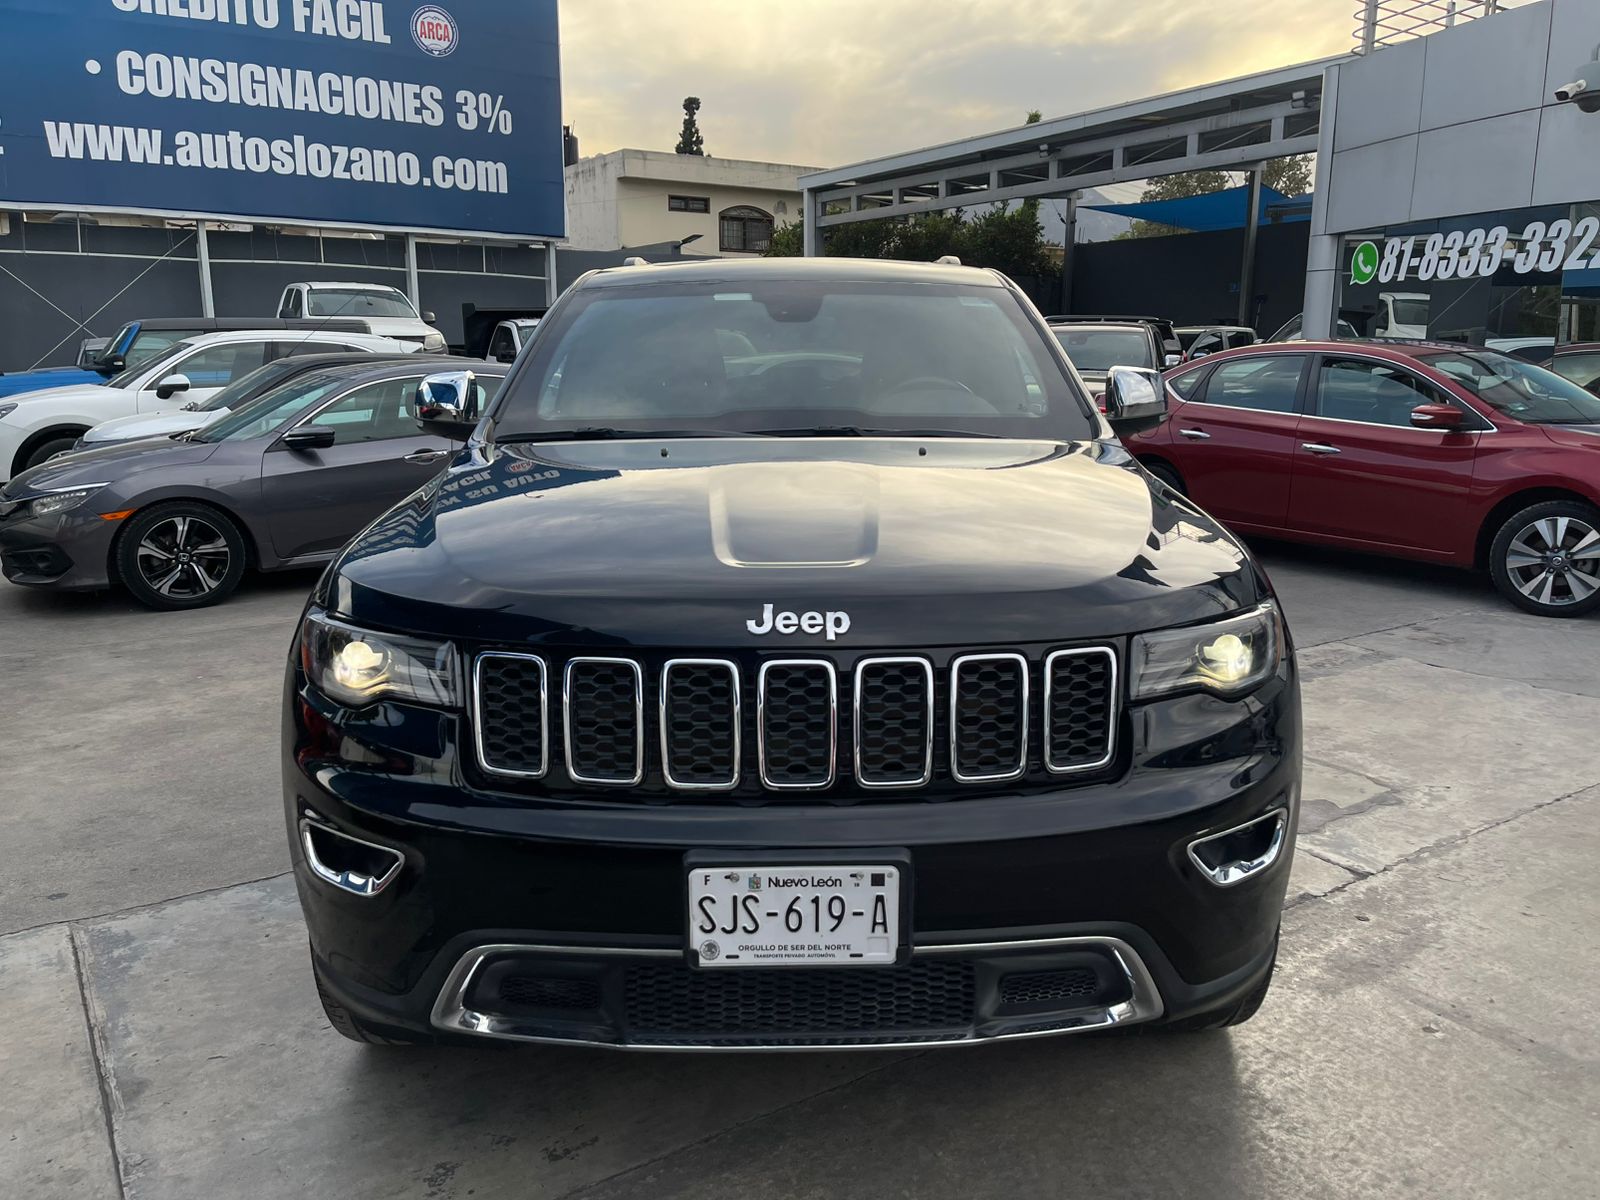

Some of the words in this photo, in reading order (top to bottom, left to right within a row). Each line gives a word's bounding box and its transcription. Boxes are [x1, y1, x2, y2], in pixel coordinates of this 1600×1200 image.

[419, 20, 451, 43] ARCA
[116, 50, 444, 127] CONSIGNACIONES
[456, 90, 513, 135] 3%
[43, 120, 508, 193] www.autoslozano.com
[1378, 216, 1600, 283] 81-8333-332
[746, 604, 851, 641] Jeep
[704, 875, 711, 886] F
[768, 877, 809, 888] Nuevo
[811, 876, 843, 888] León
[698, 895, 888, 934] SJS-619-A
[738, 944, 776, 952] ORGULLO
